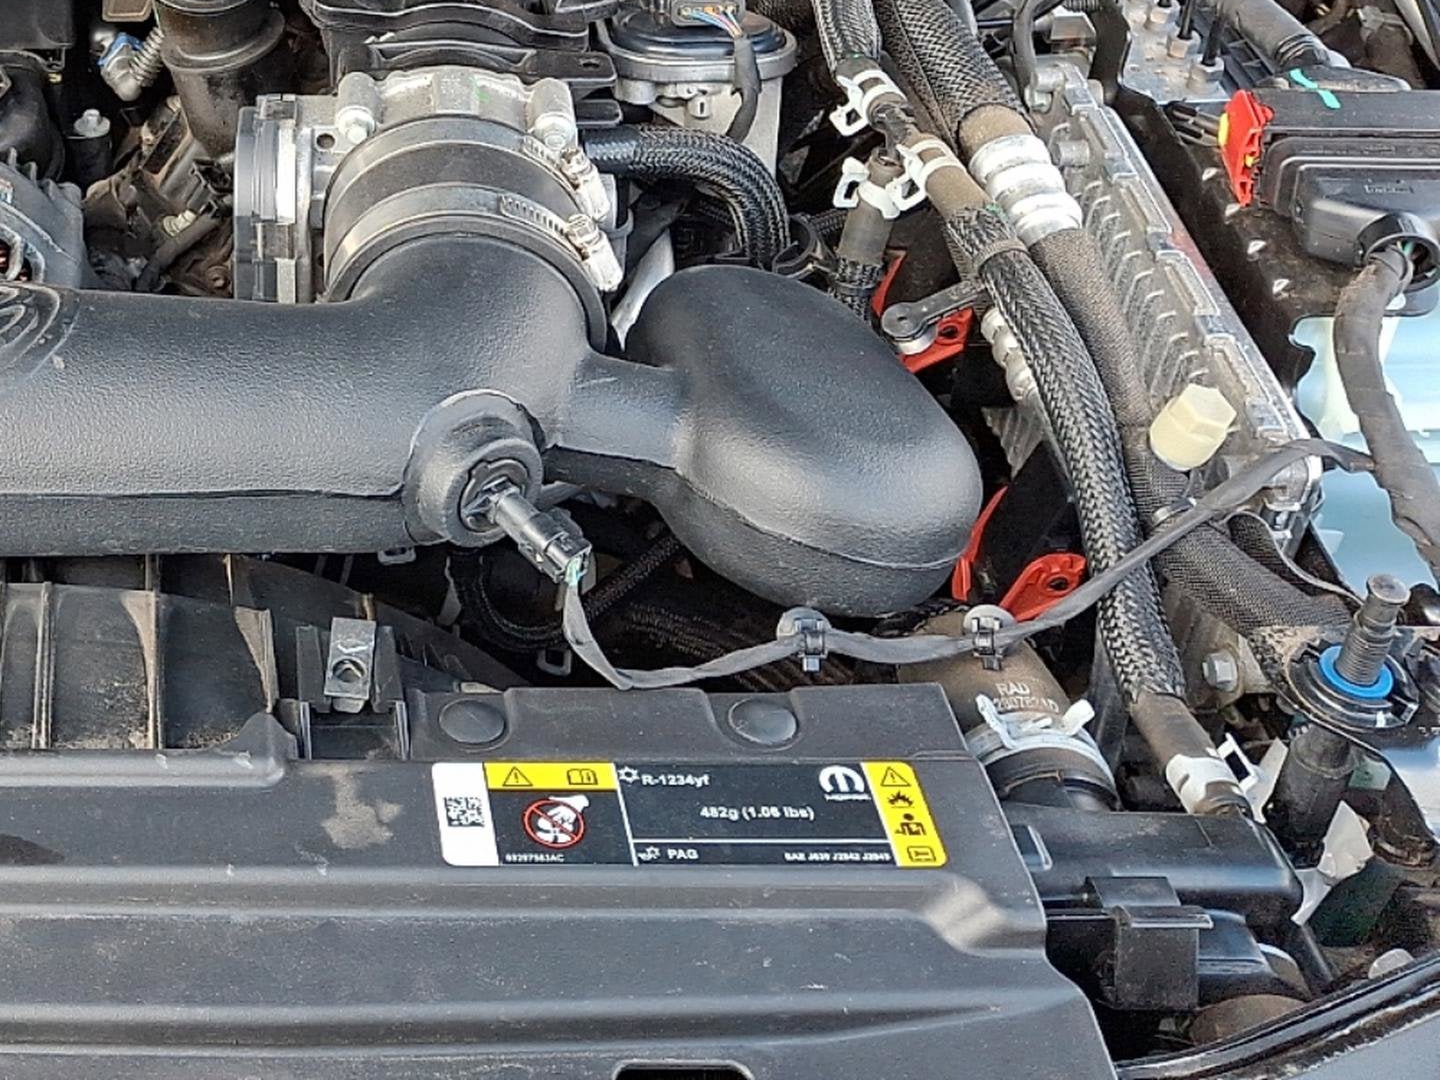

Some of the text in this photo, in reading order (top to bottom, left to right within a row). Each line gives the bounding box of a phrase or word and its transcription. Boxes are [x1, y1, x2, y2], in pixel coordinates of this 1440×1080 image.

[641, 773, 710, 788] R-1234yf
[700, 806, 739, 821] 482g
[784, 806, 815, 821] lbs)
[667, 849, 699, 860] PAG
